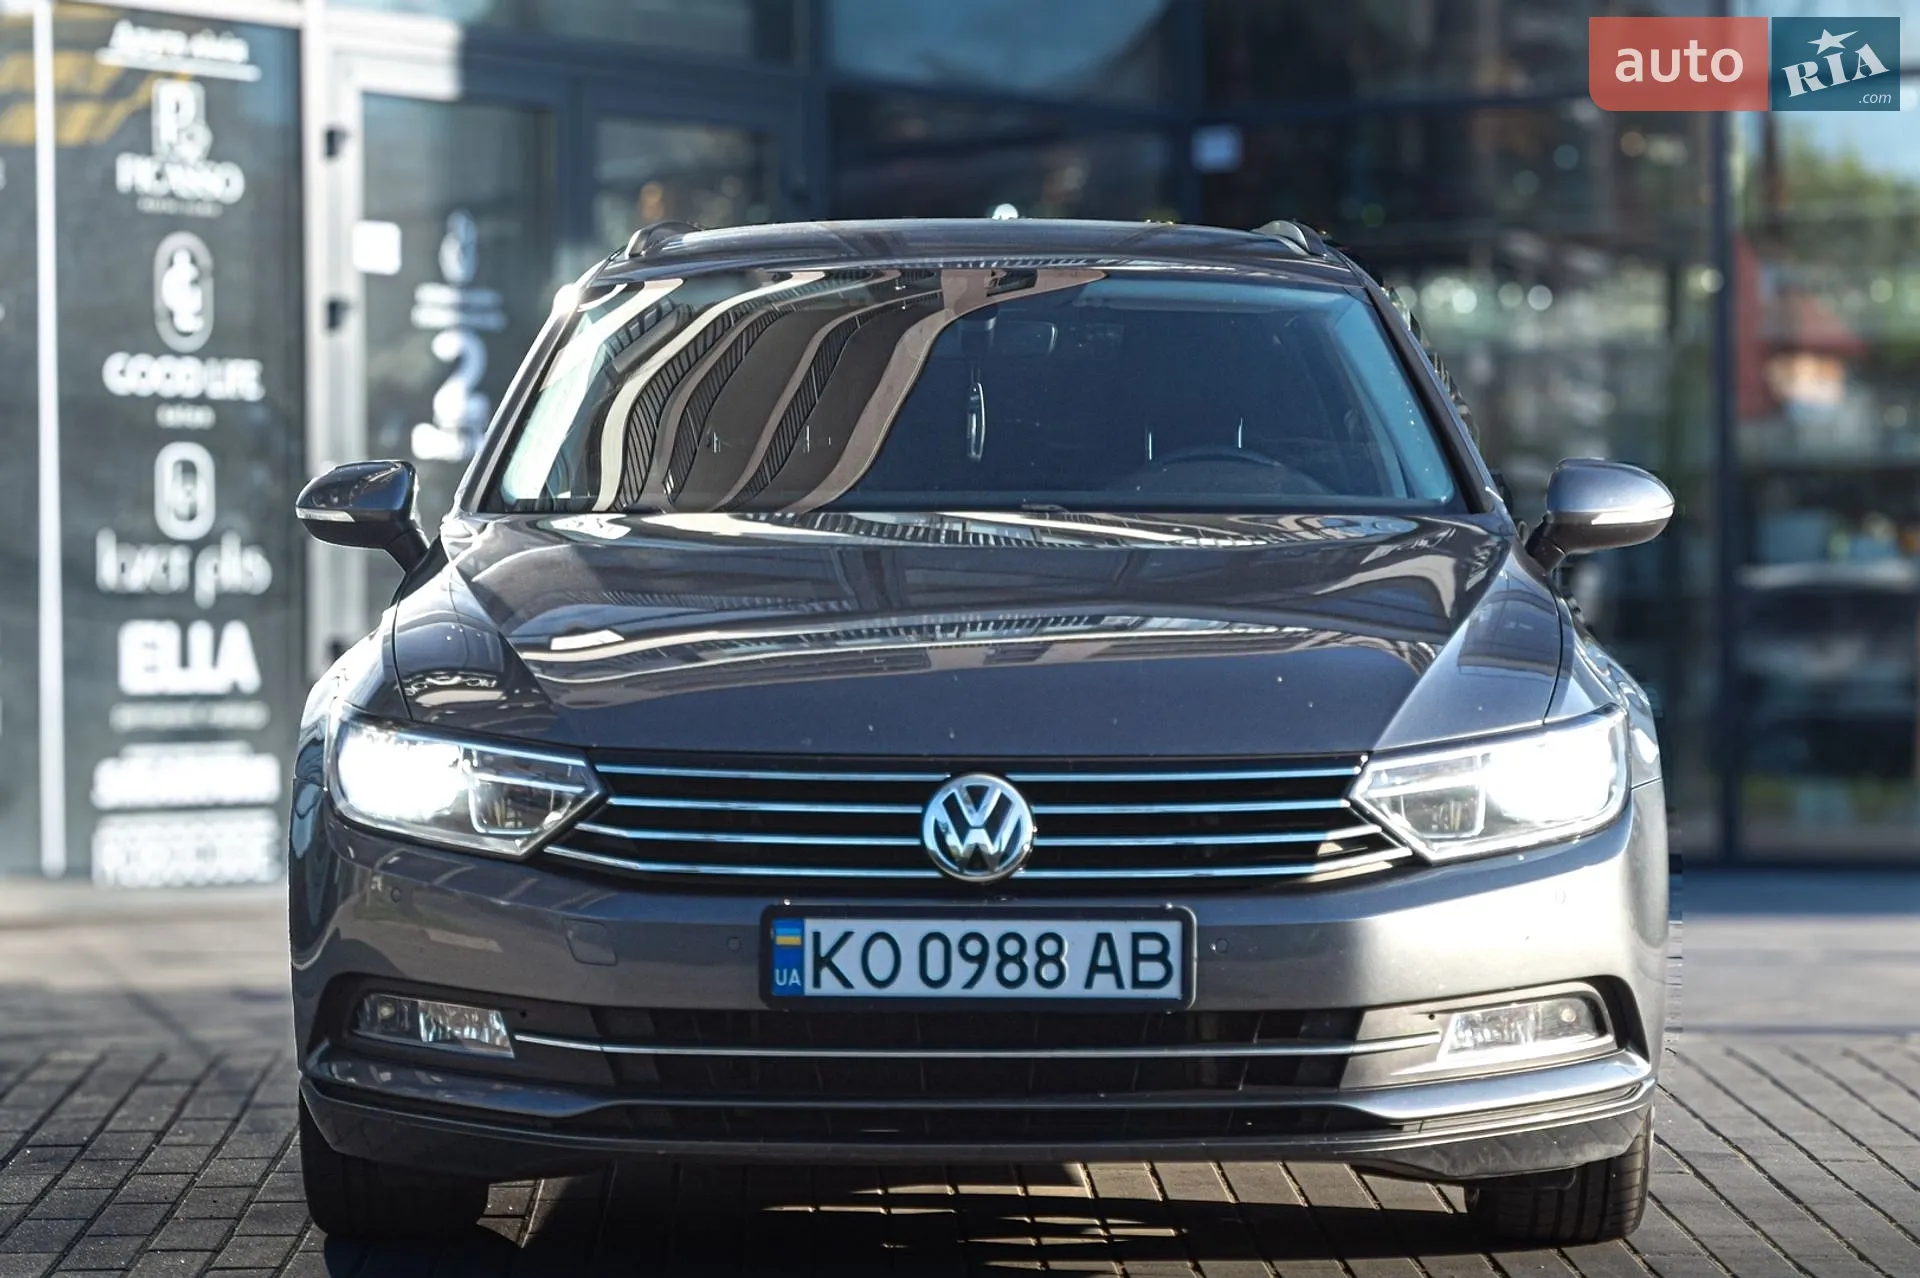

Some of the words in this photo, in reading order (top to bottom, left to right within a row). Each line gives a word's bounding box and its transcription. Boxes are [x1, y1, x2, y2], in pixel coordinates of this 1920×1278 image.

[775, 969, 801, 987] UA
[812, 930, 902, 990] KO
[918, 930, 1069, 991] 0988
[1083, 930, 1175, 991] AB
